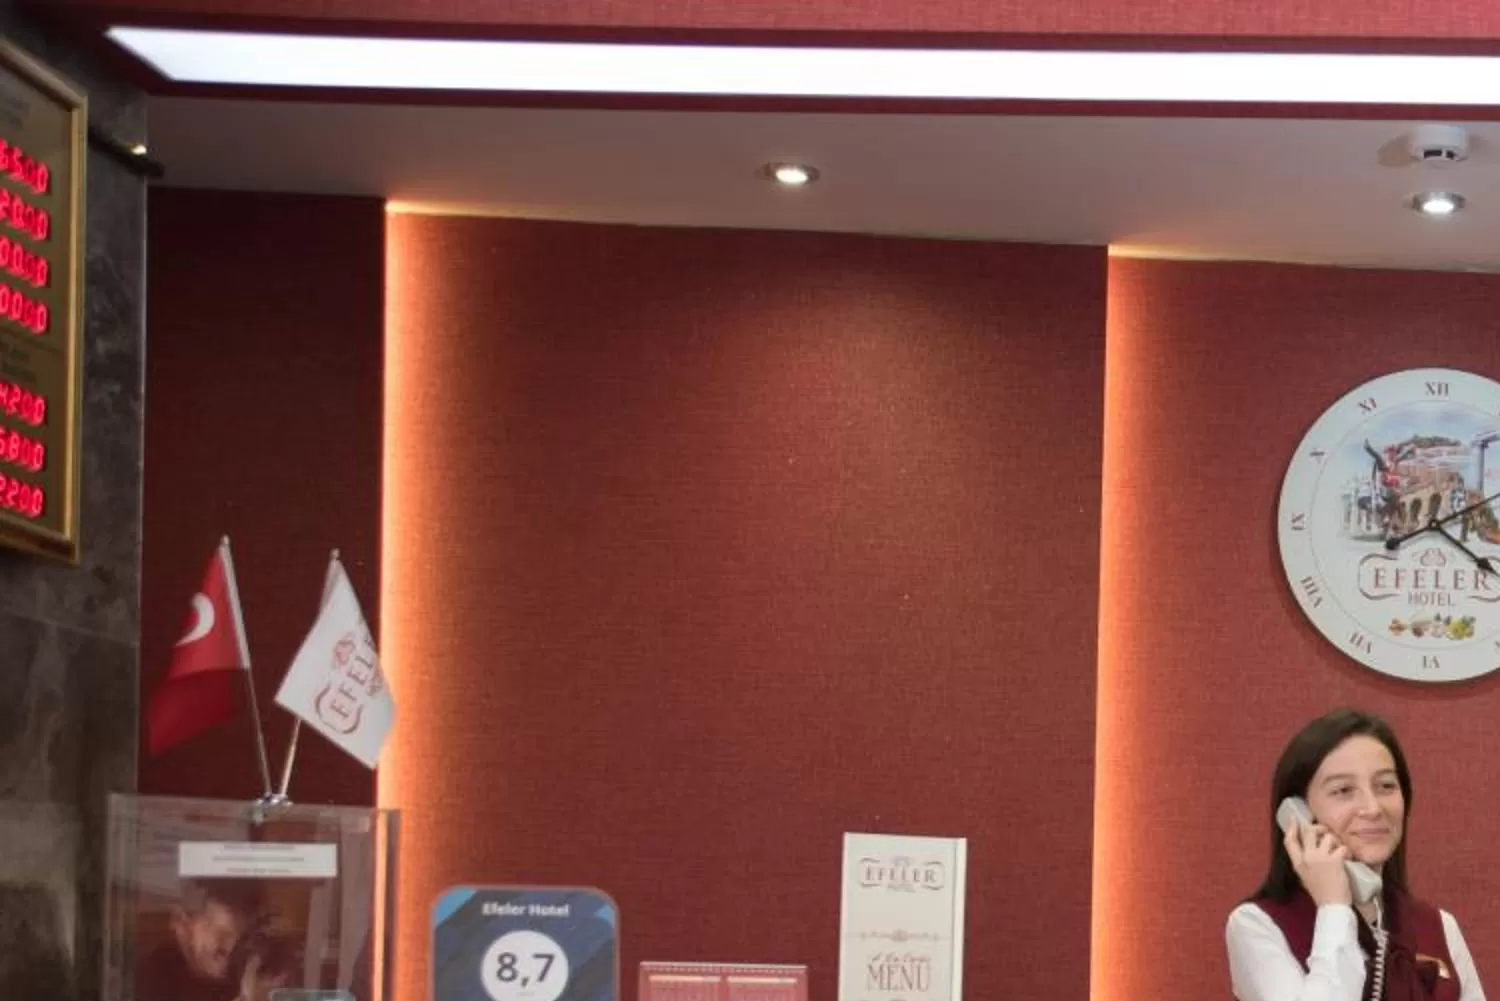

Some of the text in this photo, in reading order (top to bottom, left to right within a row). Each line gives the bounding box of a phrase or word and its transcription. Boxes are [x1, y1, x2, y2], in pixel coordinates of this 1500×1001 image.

[1424, 381, 1449, 397] XII
[1373, 567, 1492, 591] EFELER
[1407, 590, 1457, 607] HOTEL
[527, 903, 570, 918] Hotel
[496, 952, 555, 988] 8,7
[867, 963, 931, 993] MENU
